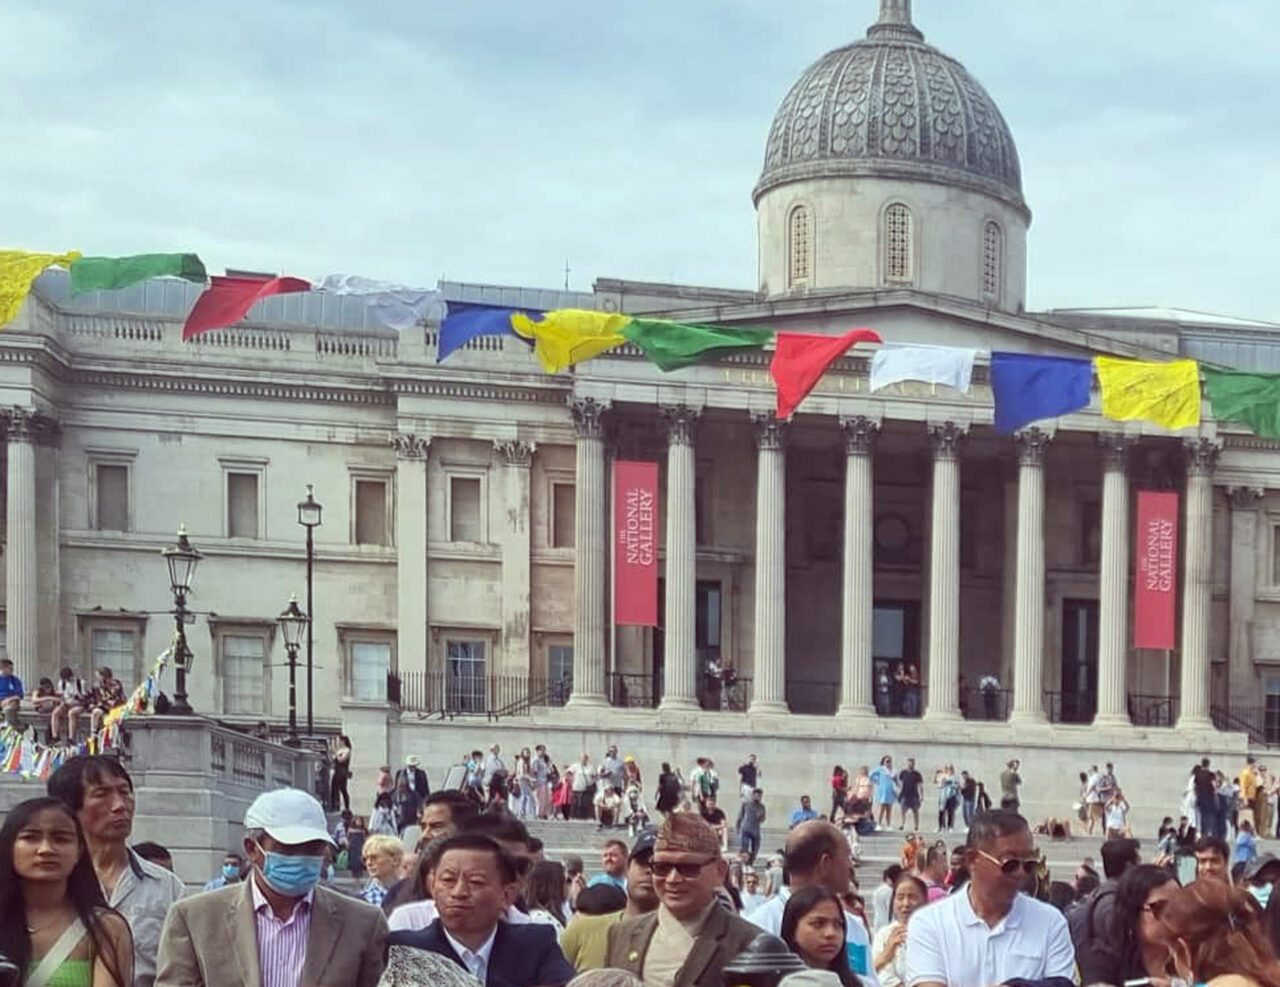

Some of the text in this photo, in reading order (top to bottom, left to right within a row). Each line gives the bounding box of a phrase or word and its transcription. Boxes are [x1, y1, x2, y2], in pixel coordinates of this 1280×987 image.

[627, 489, 639, 564] NATIONAL
[639, 489, 654, 566] GALLERY
[1147, 520, 1159, 591] NATIONAL
[1159, 520, 1174, 592] GALLERY
